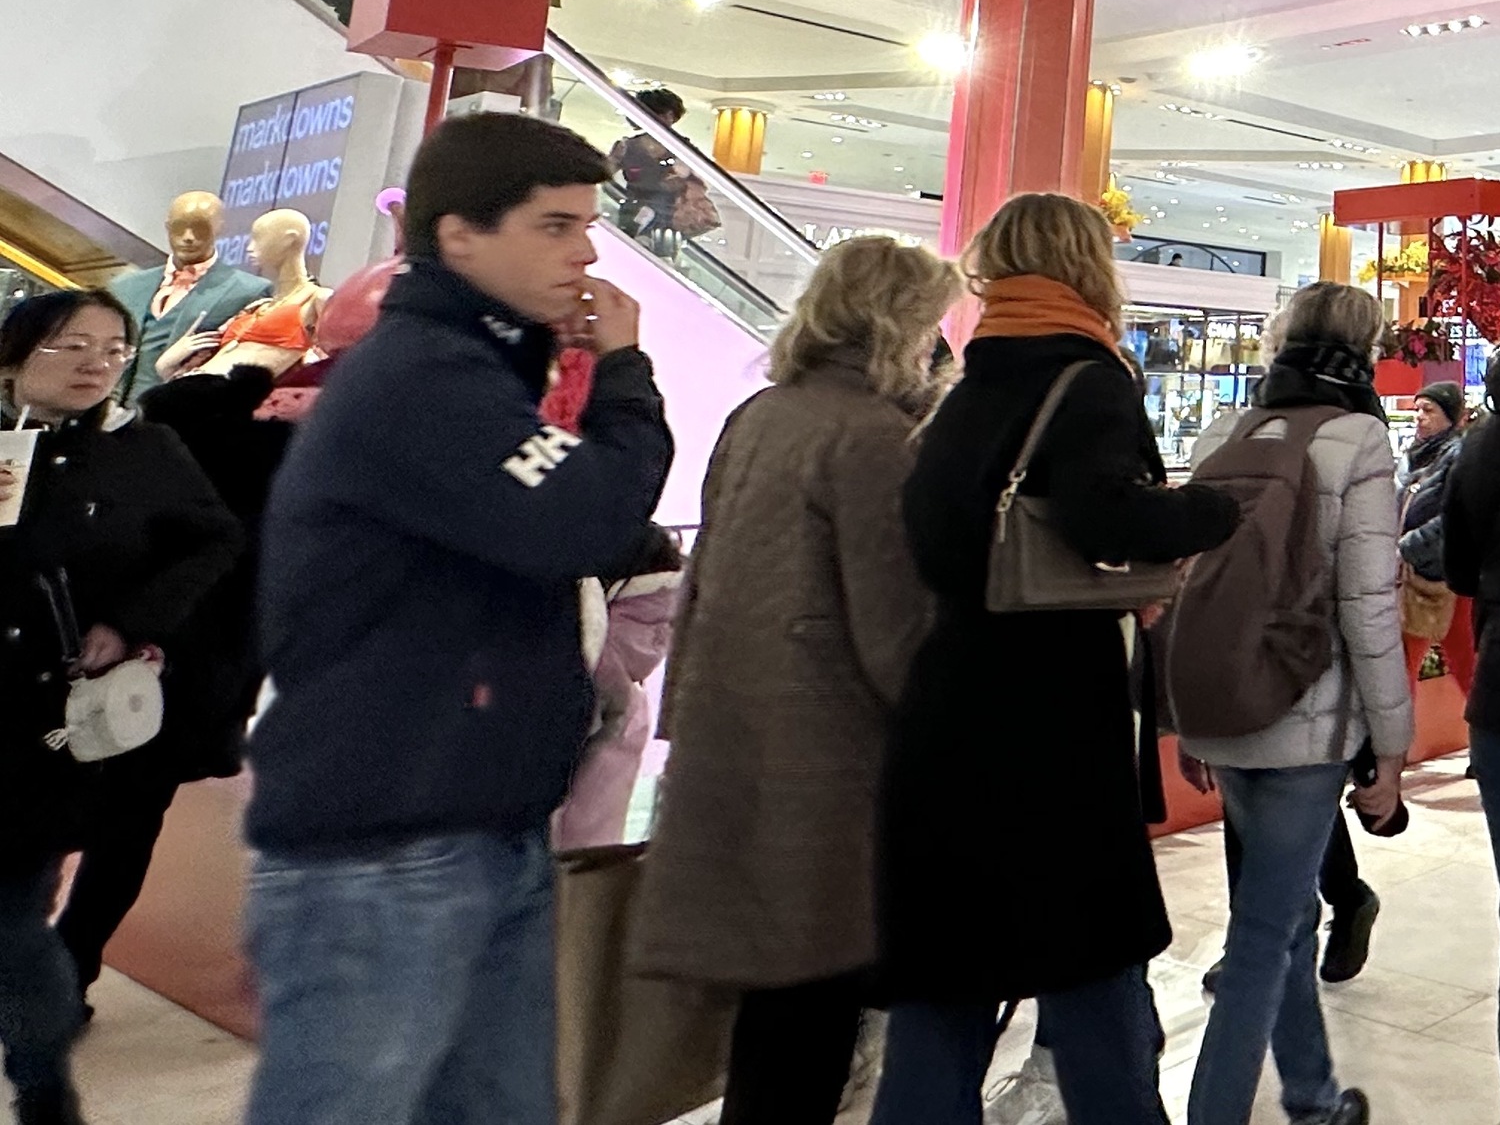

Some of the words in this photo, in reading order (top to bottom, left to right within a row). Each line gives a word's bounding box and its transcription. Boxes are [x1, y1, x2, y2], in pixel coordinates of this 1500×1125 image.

[235, 95, 354, 154] markdowns
[223, 156, 342, 208] markdowns
[501, 424, 583, 487] HH
